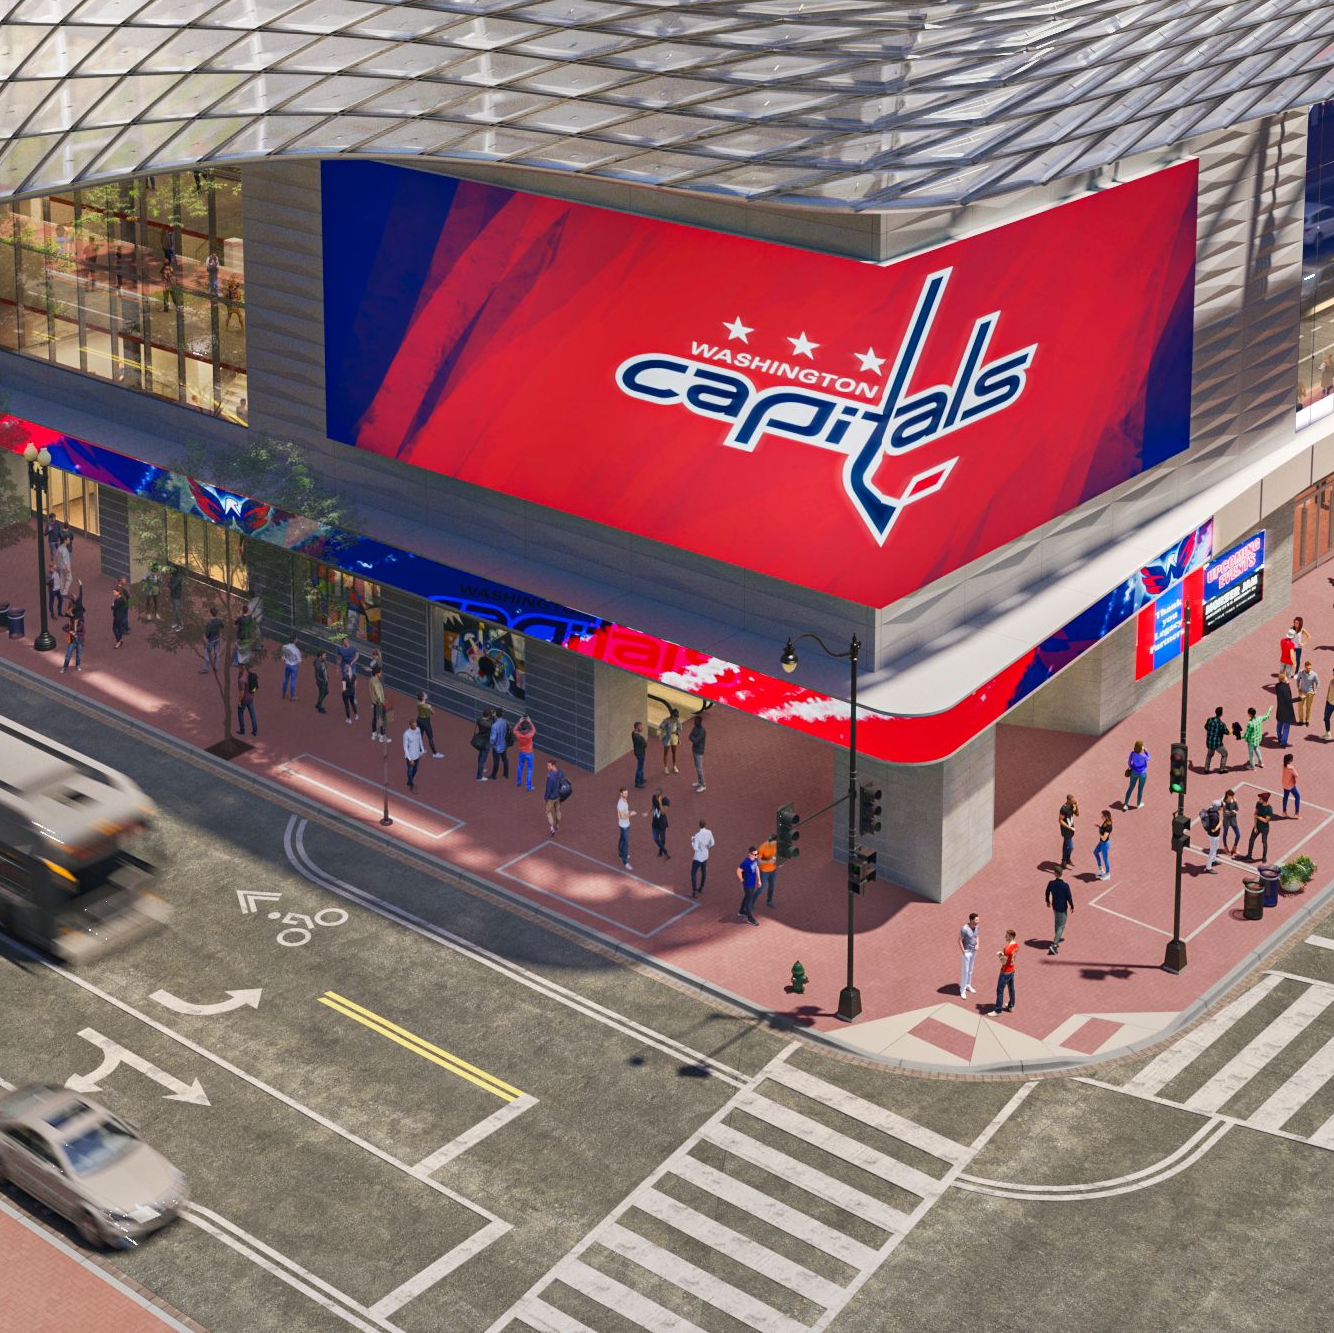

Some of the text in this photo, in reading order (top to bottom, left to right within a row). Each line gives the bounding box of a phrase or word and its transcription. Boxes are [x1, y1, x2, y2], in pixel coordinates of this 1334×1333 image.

[690, 340, 880, 399] WASHINGTON
[615, 266, 1039, 548] capitals
[1207, 538, 1260, 583] UPCOMING
[1219, 552, 1256, 589] EVENTS
[1155, 599, 1182, 619] Thank
